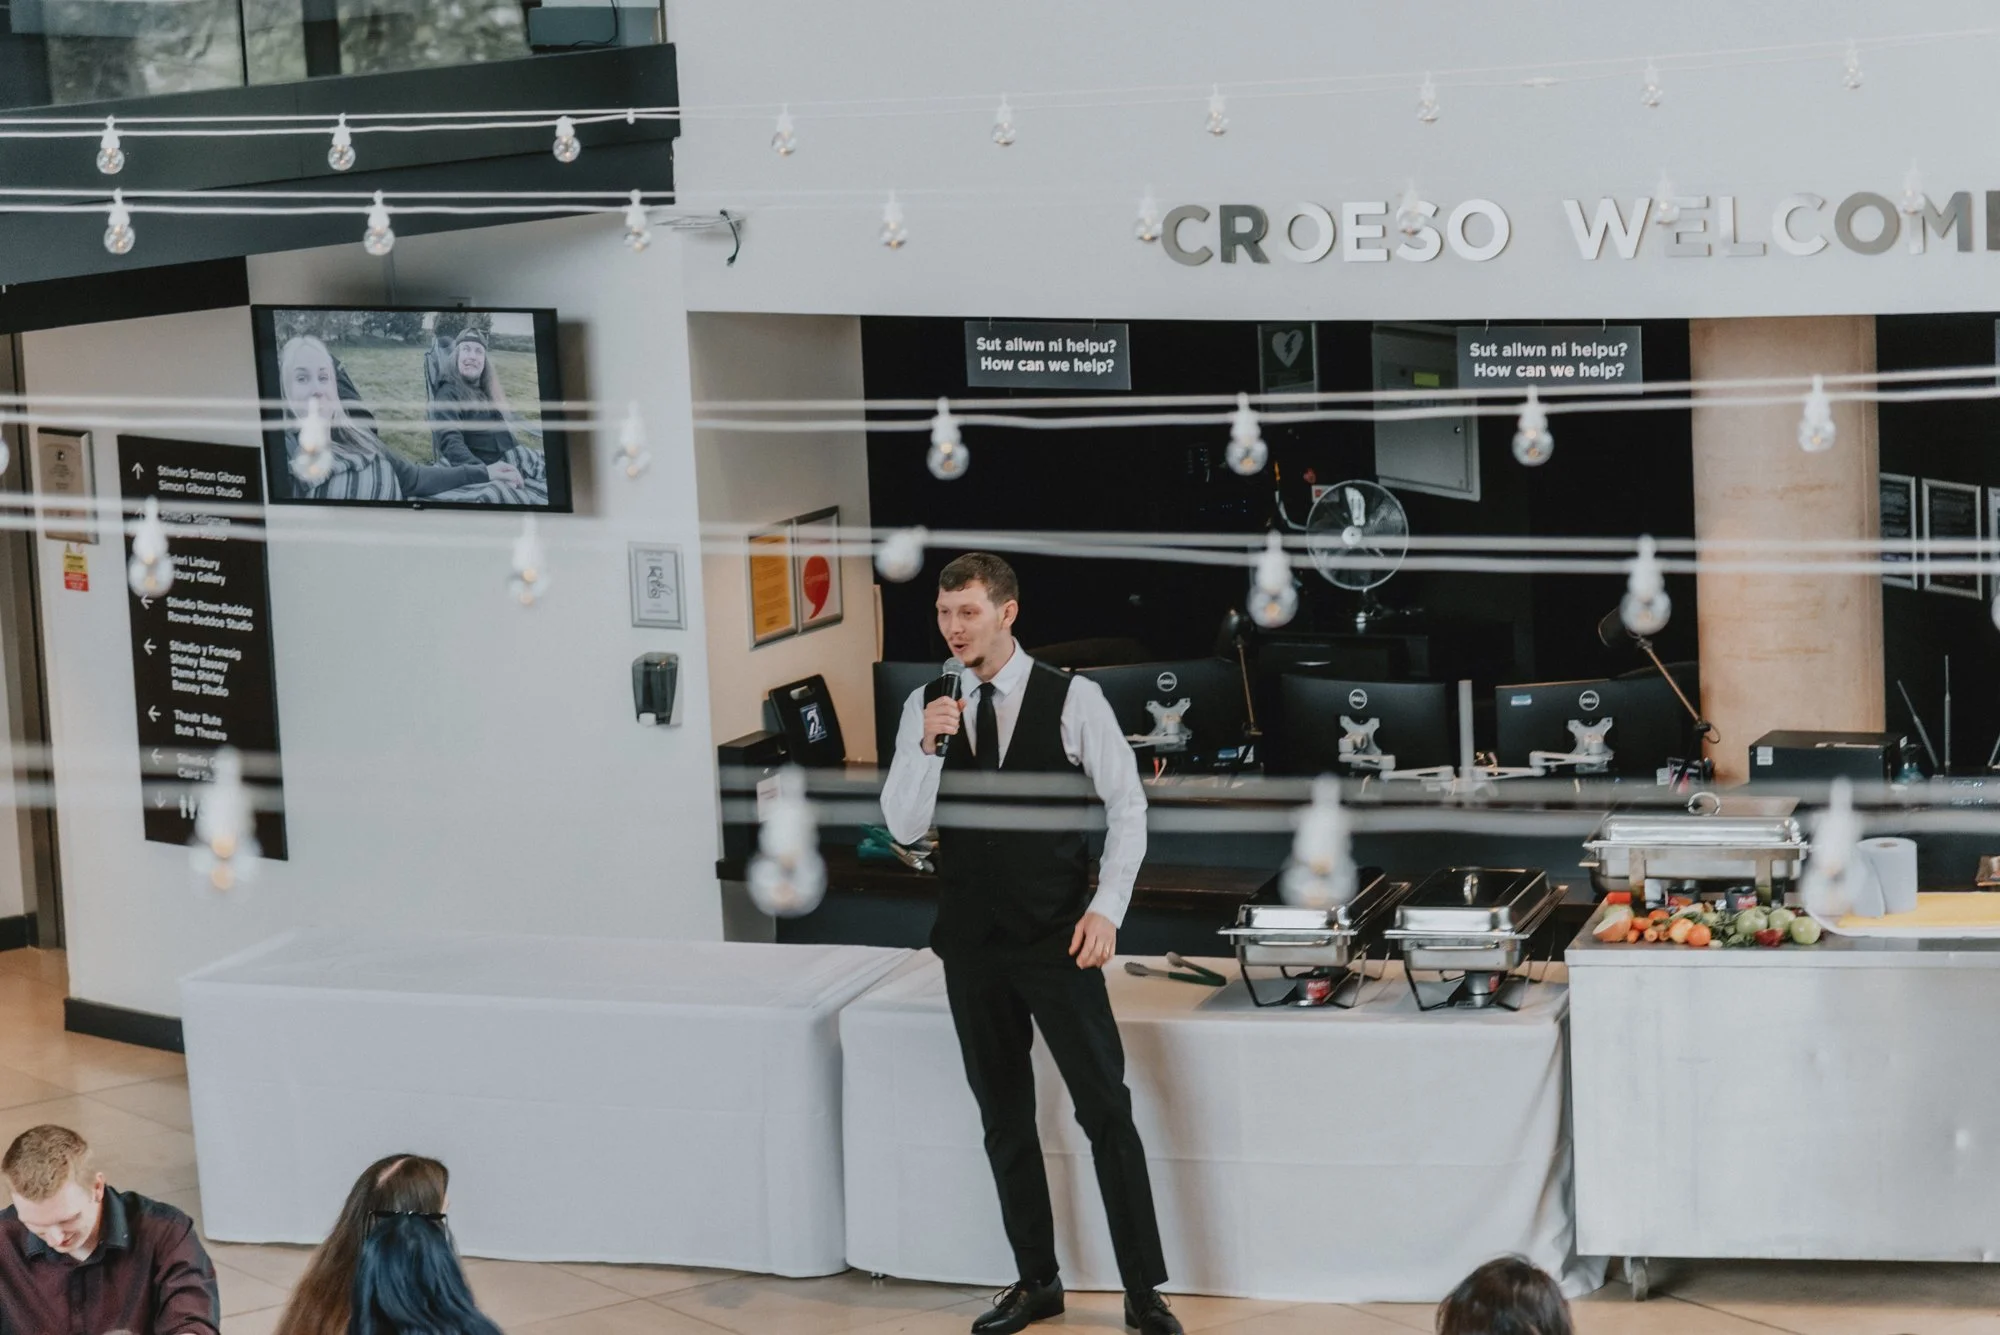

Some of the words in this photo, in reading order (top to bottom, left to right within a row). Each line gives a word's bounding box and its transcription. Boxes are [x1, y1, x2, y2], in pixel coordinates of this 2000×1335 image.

[1160, 198, 1511, 267] CROESO
[976, 337, 1002, 351] Sut
[1005, 337, 1045, 352] allwn
[1048, 338, 1062, 353] ni
[1066, 338, 1117, 356] helpu?
[1470, 342, 1498, 357] Sut
[1502, 342, 1546, 357] allwn
[1551, 342, 1567, 357] ni
[1571, 342, 1628, 360] helpu?
[980, 356, 1014, 371] How
[1017, 359, 1045, 372] can
[1048, 359, 1070, 372] we
[1073, 358, 1115, 375] help?
[1474, 362, 1511, 377] How
[1516, 364, 1546, 378] can
[1550, 364, 1574, 378] we
[1579, 362, 1625, 380] help?
[157, 465, 189, 479] Stiwdio
[189, 468, 216, 481] Simon
[217, 471, 247, 485] Gibson
[158, 479, 185, 493] Simon
[185, 482, 215, 495] Gibson
[215, 485, 243, 498] Studio
[196, 571, 226, 586] Gallery
[166, 596, 197, 610] Stiwdio
[226, 618, 253, 632] Studio
[169, 640, 201, 654] Stiwdio
[171, 666, 196, 679] Dame
[197, 669, 225, 685] Shirley
[201, 683, 229, 697] Studio
